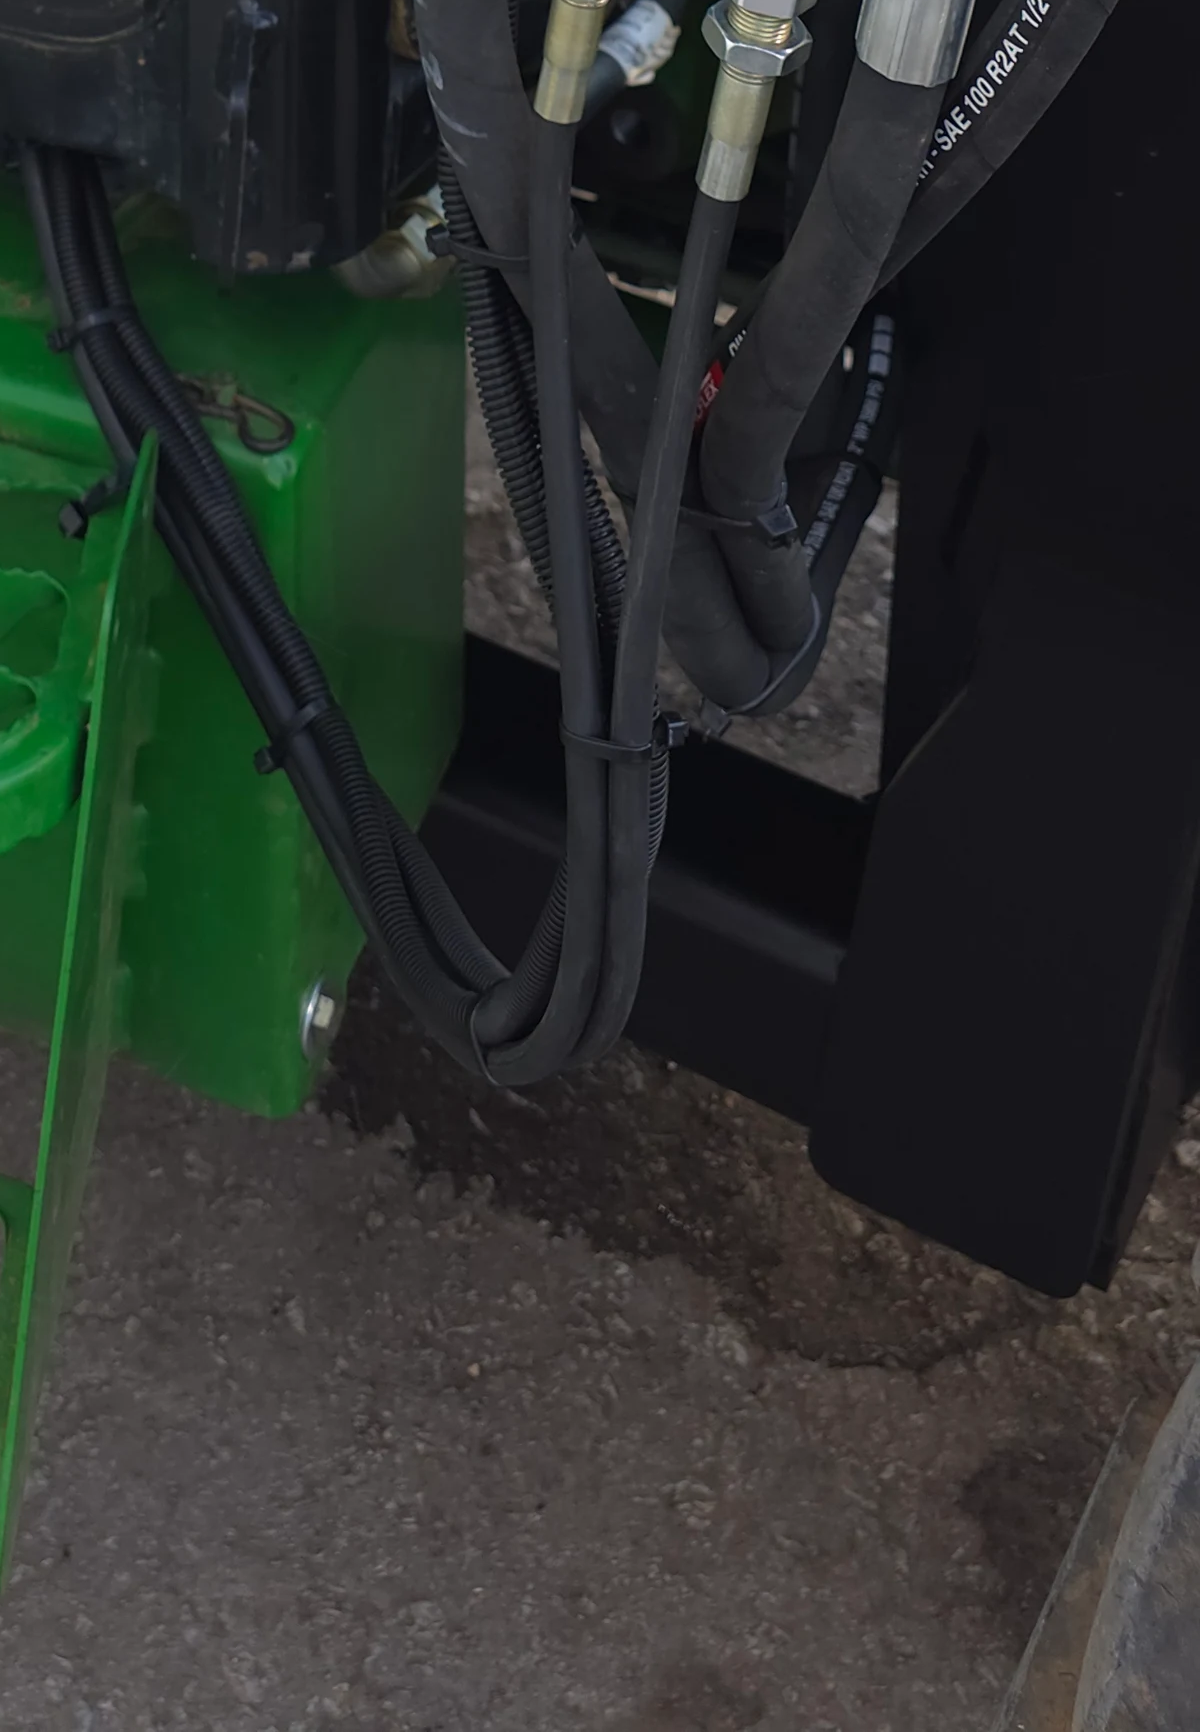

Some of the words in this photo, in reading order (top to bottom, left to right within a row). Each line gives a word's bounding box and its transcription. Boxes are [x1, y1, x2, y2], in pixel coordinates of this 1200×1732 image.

[933, 105, 973, 153] SAE
[963, 76, 996, 115] 100
[985, 22, 1029, 86] R2AT
